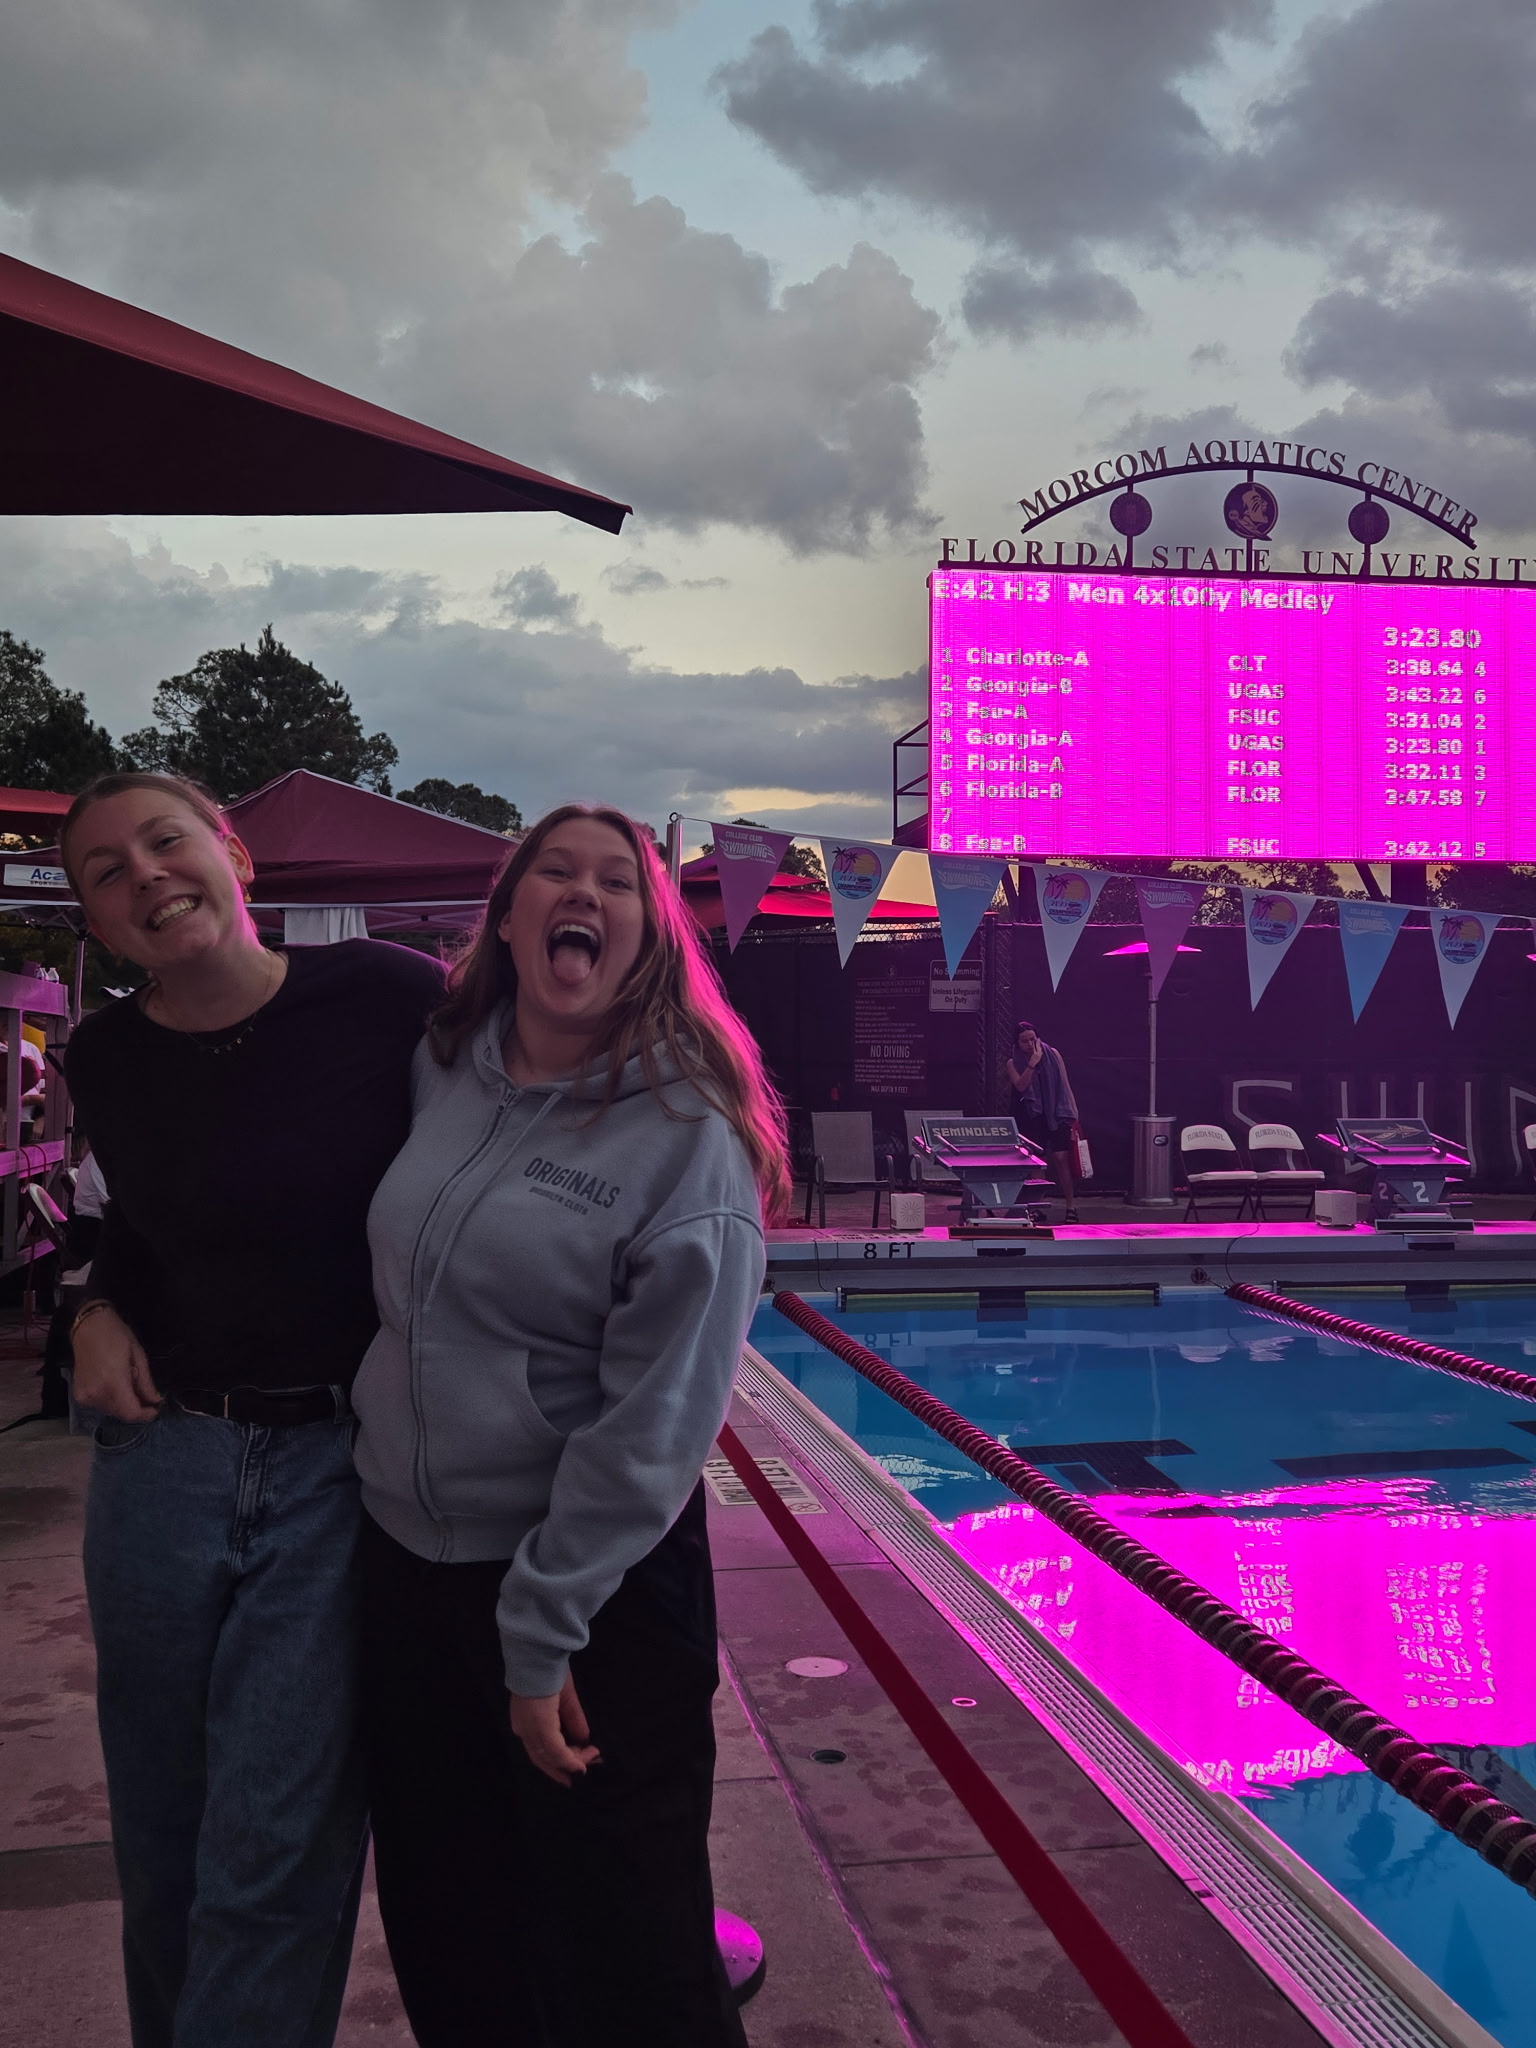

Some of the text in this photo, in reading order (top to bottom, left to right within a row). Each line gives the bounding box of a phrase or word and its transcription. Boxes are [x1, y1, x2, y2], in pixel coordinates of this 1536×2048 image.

[1016, 446, 1167, 523] MORCOM
[1185, 440, 1346, 476] AQUATICS
[1357, 461, 1479, 543] CENTER
[940, 538, 1536, 581] FLORIDA STATE UNIVERSIT
[934, 578, 1334, 615] E:42 H:3 Men 4x100y Medley
[1383, 627, 1482, 649] 3:23.80
[942, 647, 953, 664] 1
[966, 648, 1089, 667] Charlotte-A
[1228, 655, 1267, 672] CLT
[1474, 661, 1486, 677] 4
[941, 675, 1486, 704] 2 Georgia-B UGAS 3:43.22 6
[940, 702, 953, 718] 3
[1228, 708, 1280, 725] FSUC
[1386, 712, 1463, 729] 3:31.04
[1474, 714, 1486, 730] 2
[940, 728, 1486, 755] 4 Georgia-A UGAS 3:23.80 1
[941, 754, 1486, 781] 5 Florida-A FLOR 3:32.11 3
[940, 781, 1487, 806] 6 Florida-B FLOR 3:47.58 7
[941, 808, 953, 824] 7
[725, 831, 763, 843] COLLEGE CLUB
[1227, 838, 1280, 854] FSUC
[1385, 841, 1463, 857] 3:42.12
[1475, 842, 1486, 857] 5
[723, 841, 769, 859] SWIMMING
[942, 870, 987, 888] SWIMMING
[1146, 890, 1187, 904] SWIMMING
[945, 968, 980, 976] Smming
[870, 1045, 910, 1058] NO DIVING
[932, 1127, 1010, 1137] SEMINOLES
[523, 1157, 620, 1208] ORIGINALS
[1377, 1182, 1389, 1200] 2
[1412, 1181, 1430, 1203] 2
[863, 1241, 915, 1259] 8 FT
